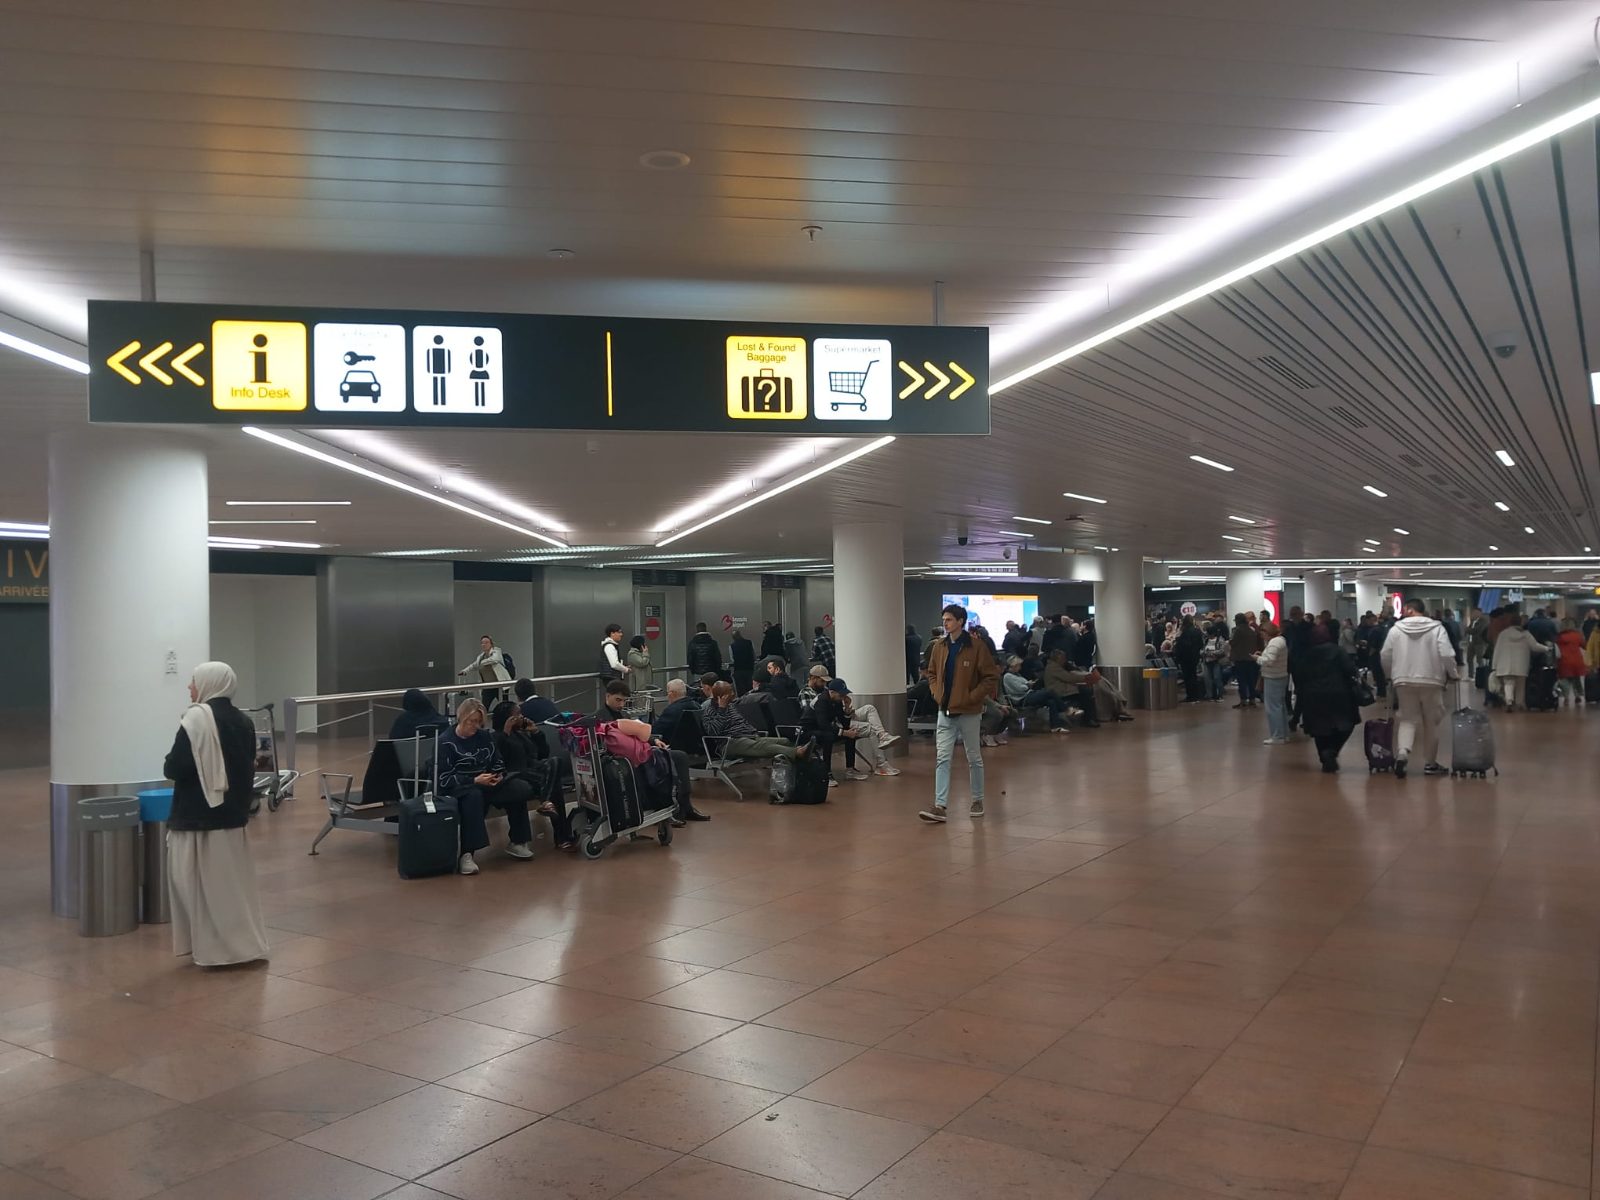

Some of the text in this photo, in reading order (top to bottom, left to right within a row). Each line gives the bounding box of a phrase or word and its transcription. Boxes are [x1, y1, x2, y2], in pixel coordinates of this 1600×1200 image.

[737, 342, 796, 352] Lost & Found
[824, 344, 881, 354] Supermarket
[747, 353, 786, 362] Baggage
[231, 386, 290, 399] Info Desk
